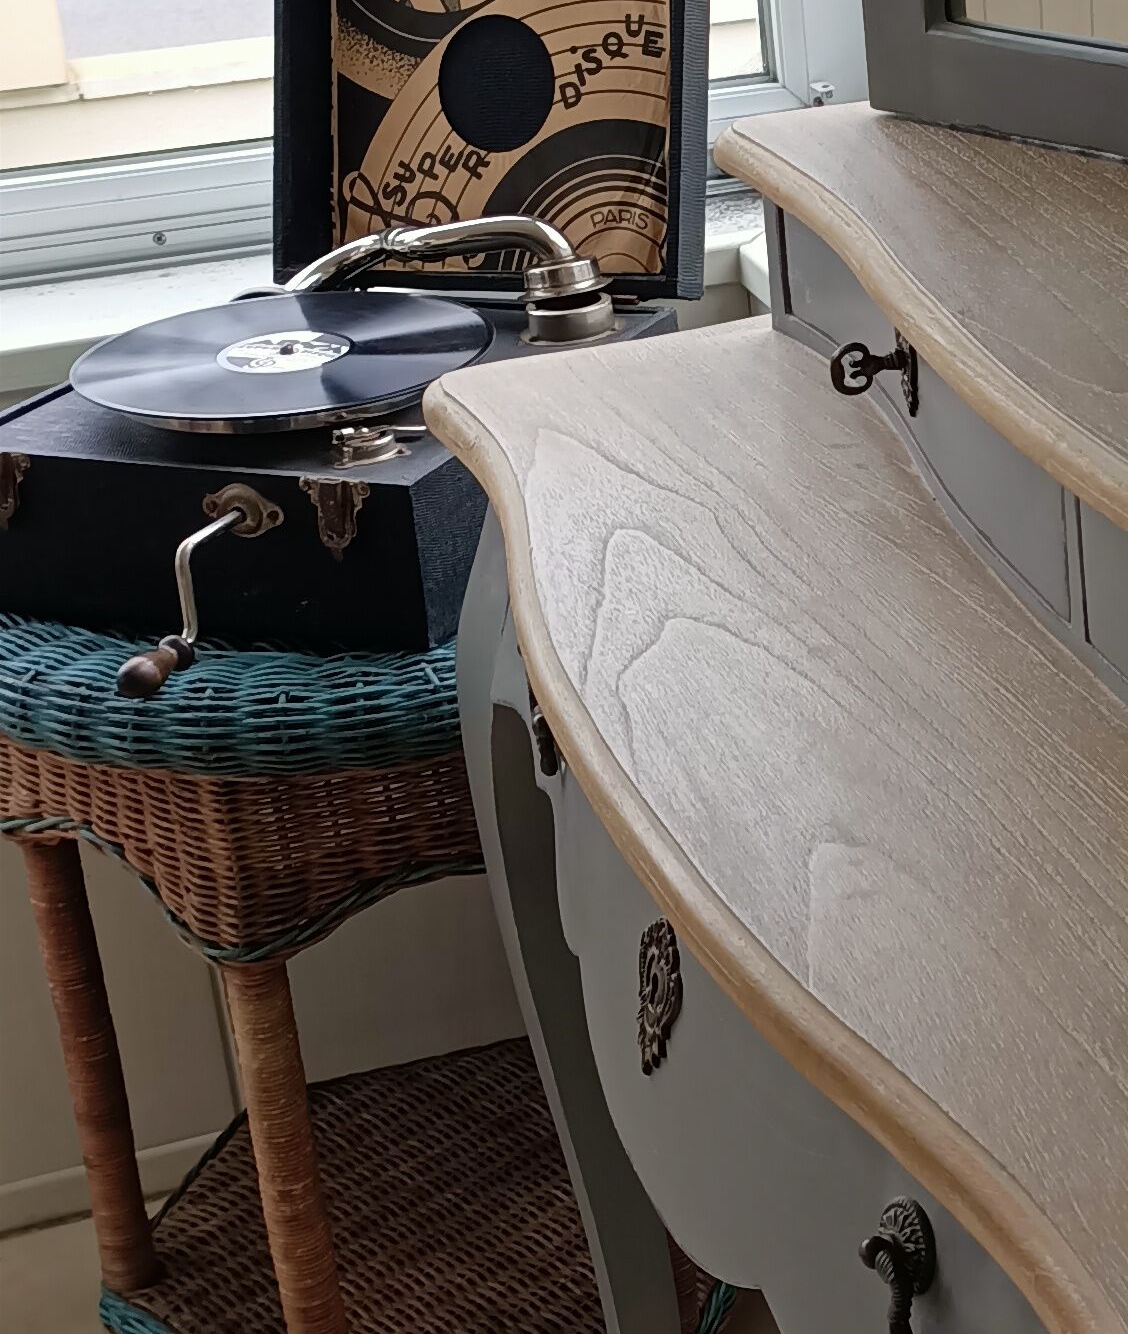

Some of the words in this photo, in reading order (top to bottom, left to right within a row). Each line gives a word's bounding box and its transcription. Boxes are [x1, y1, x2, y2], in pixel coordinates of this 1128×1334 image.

[382, 144, 490, 207] SUPER
[559, 14, 664, 110] DISQUE
[590, 209, 650, 229] PARIS
